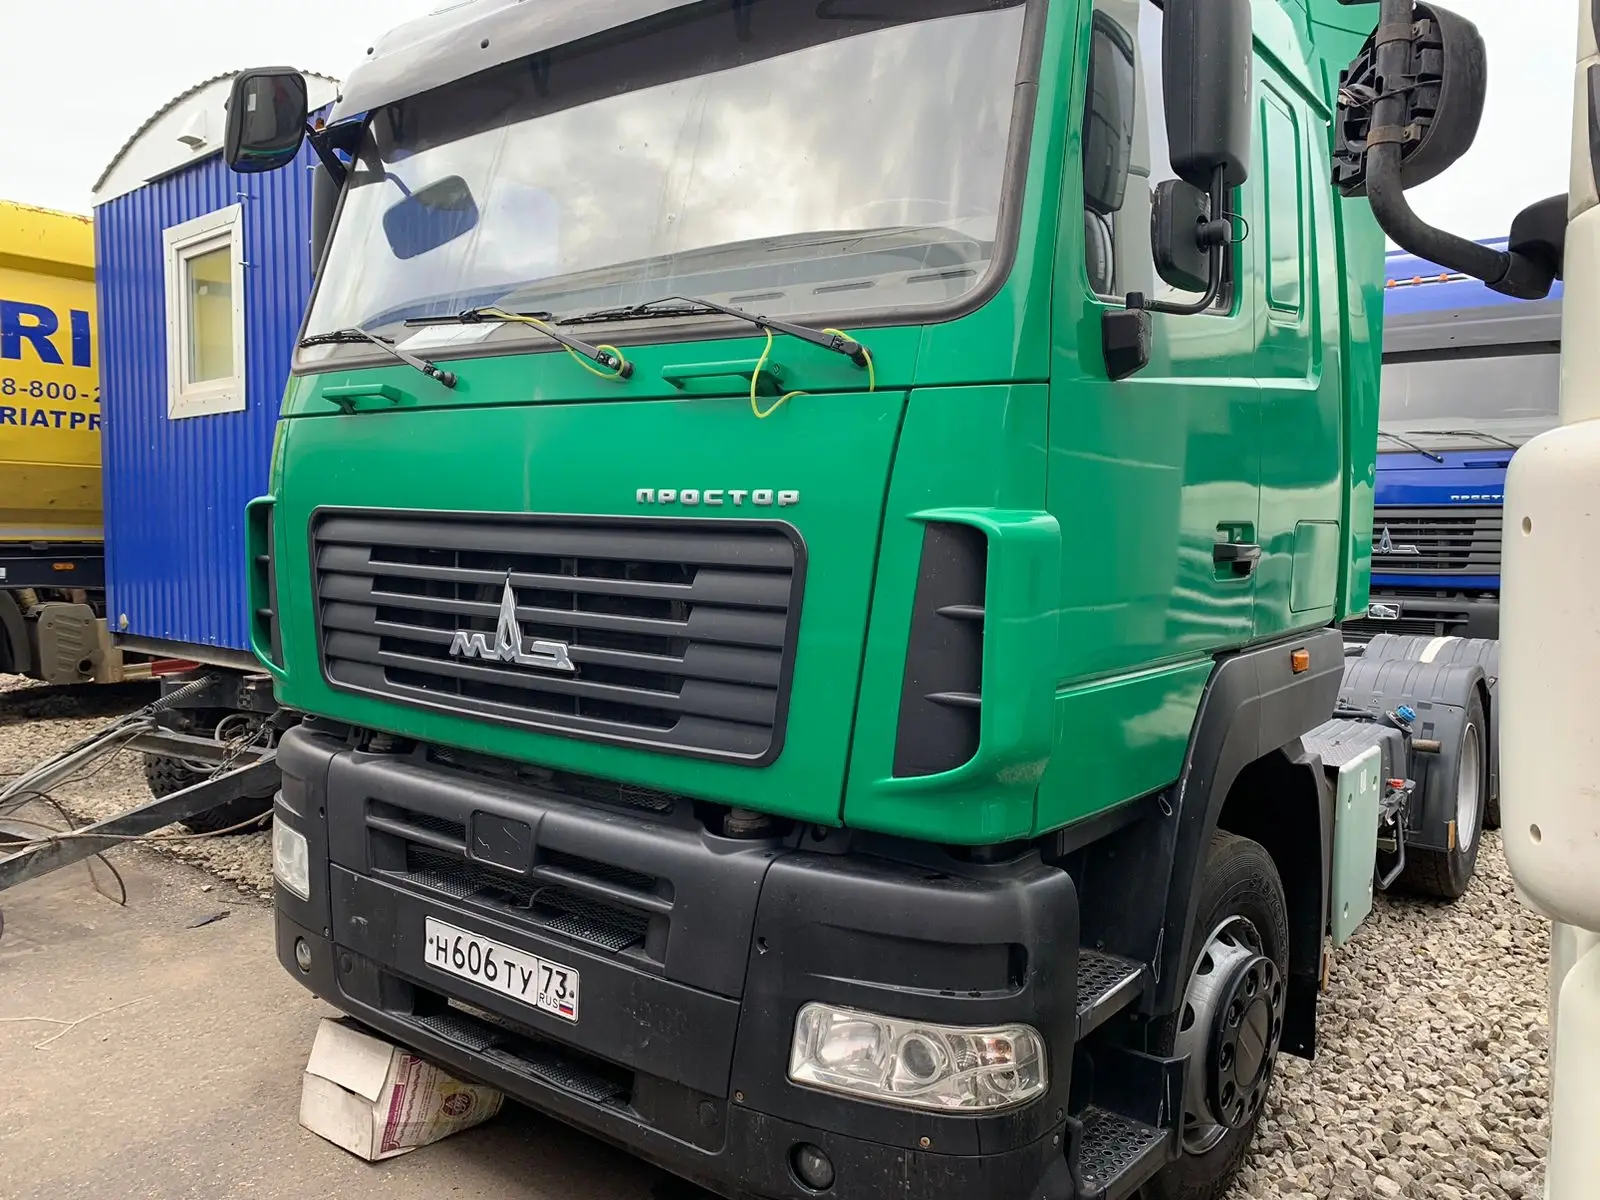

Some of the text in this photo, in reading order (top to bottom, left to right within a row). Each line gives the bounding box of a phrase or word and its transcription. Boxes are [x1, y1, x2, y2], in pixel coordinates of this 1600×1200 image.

[636, 488, 800, 507] ПРОСТОР
[449, 568, 576, 671] МАЗ
[538, 992, 559, 1009] RUS
